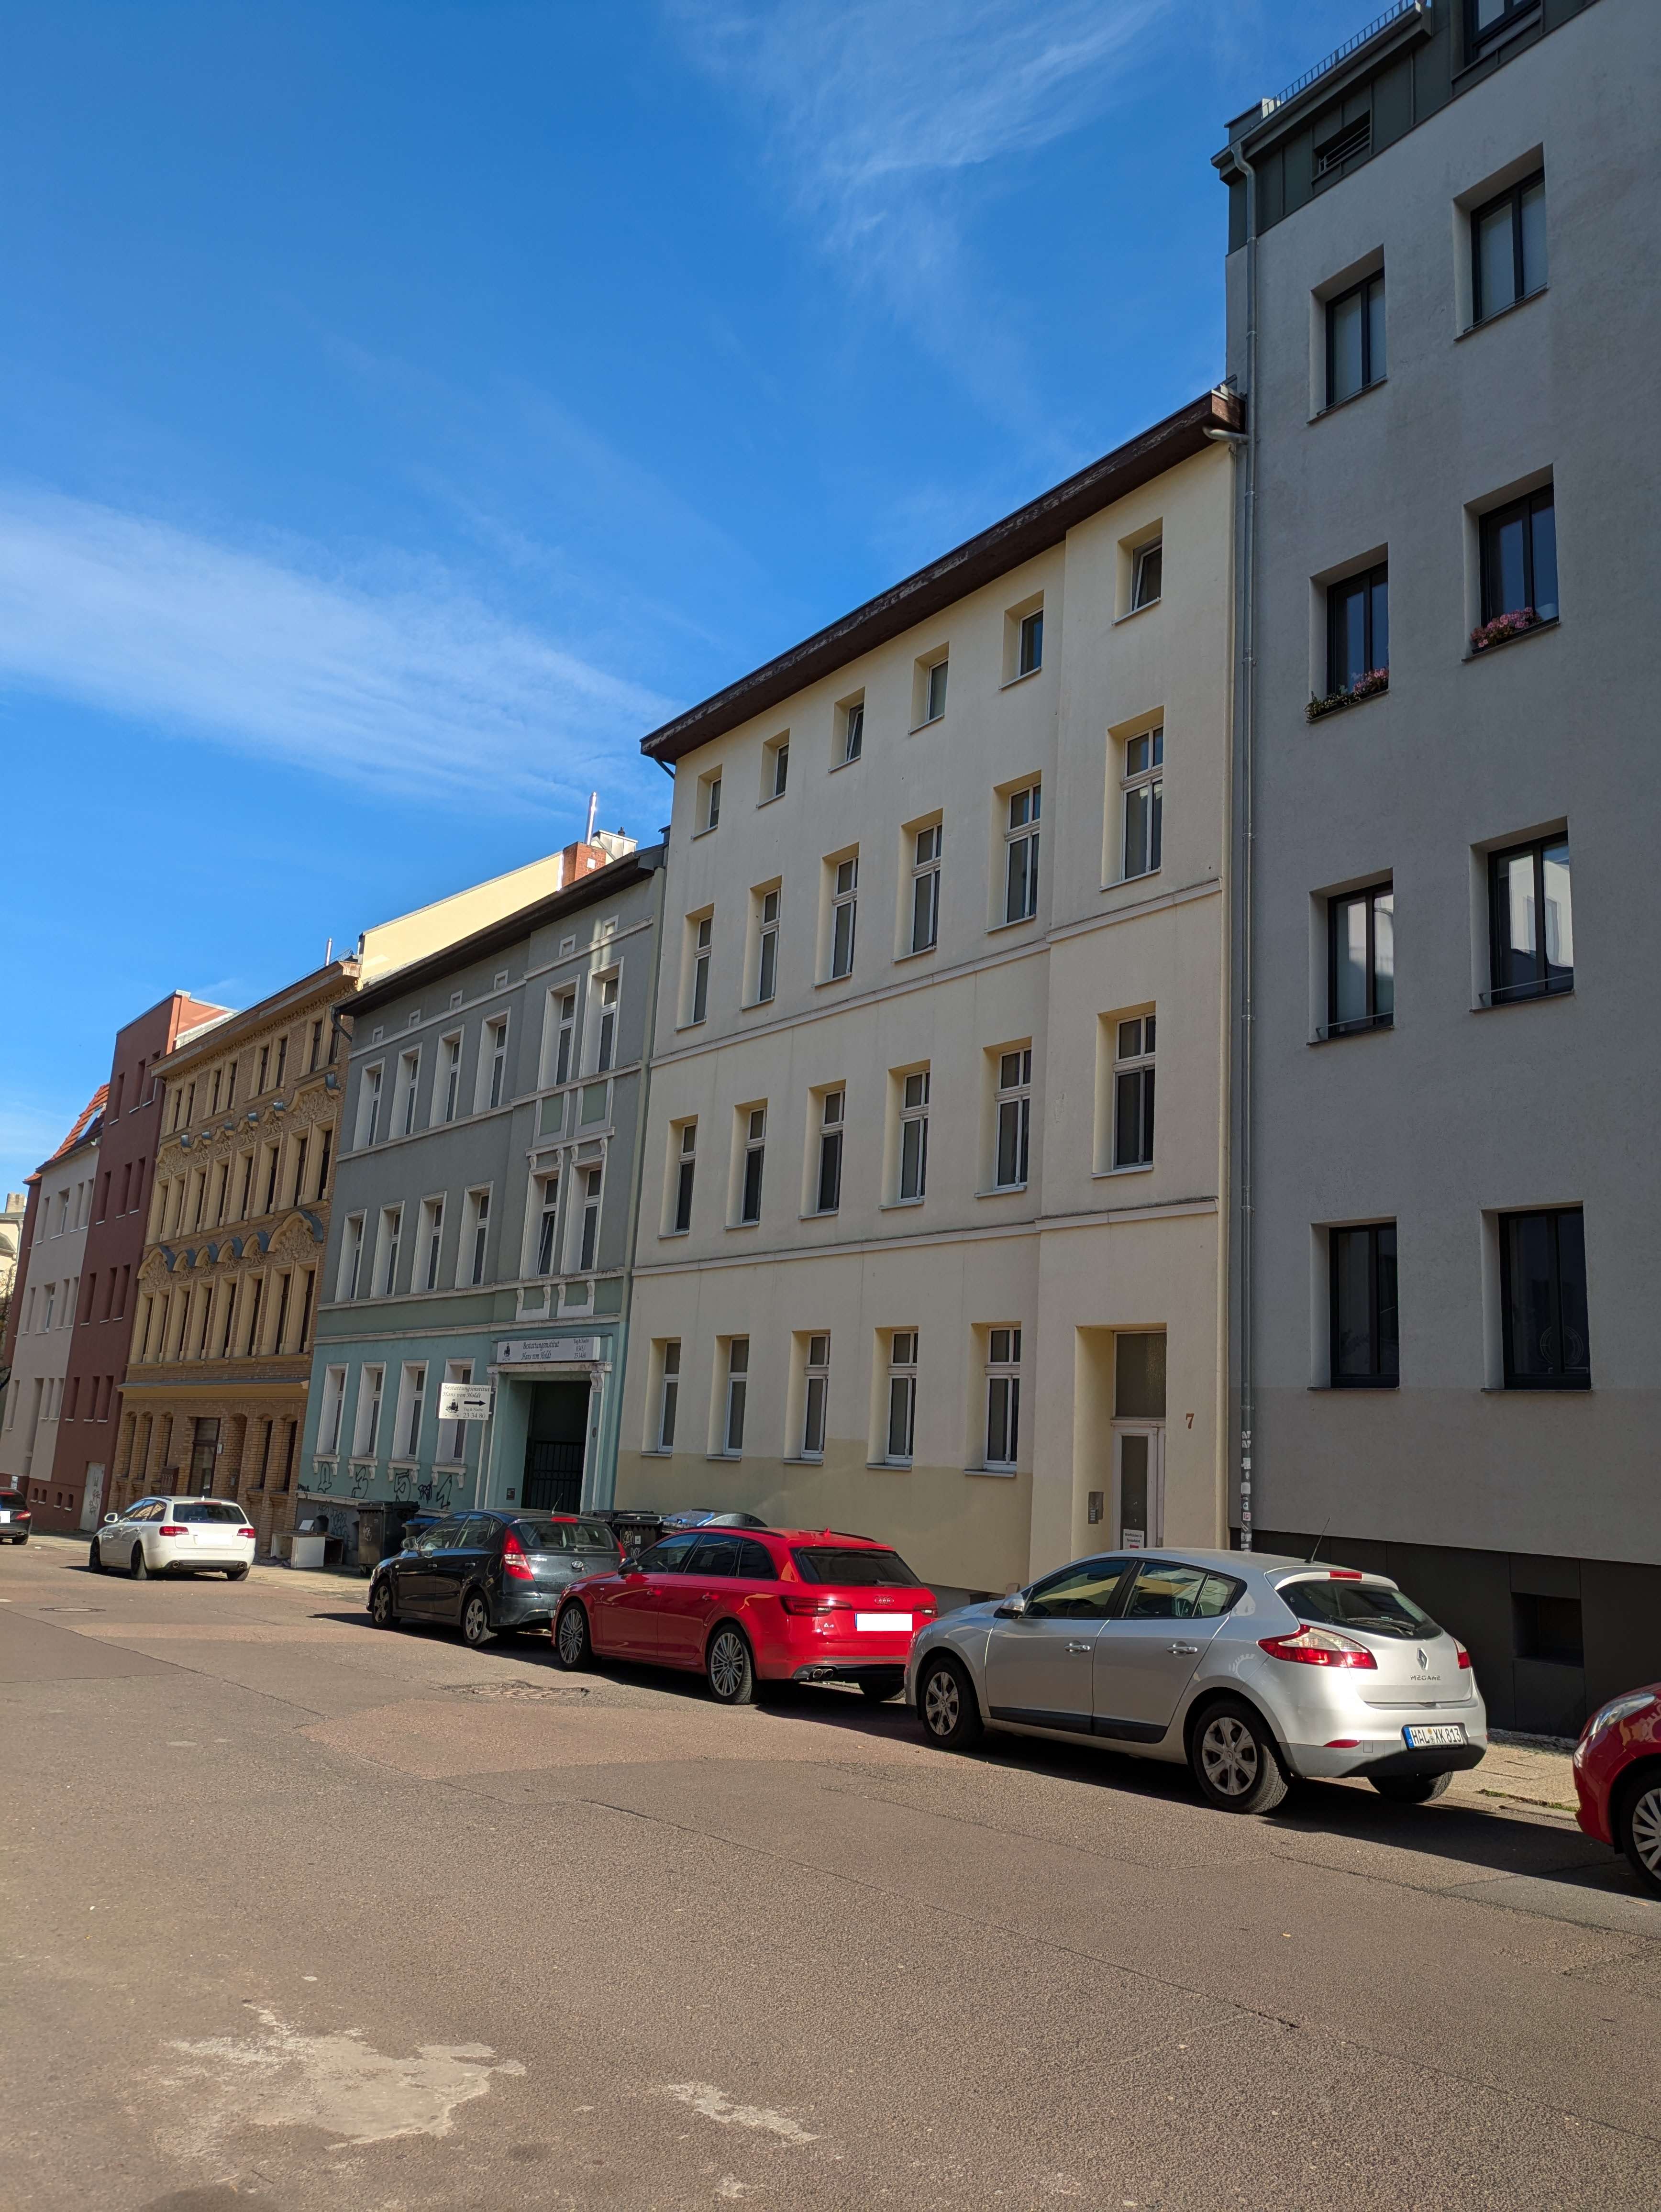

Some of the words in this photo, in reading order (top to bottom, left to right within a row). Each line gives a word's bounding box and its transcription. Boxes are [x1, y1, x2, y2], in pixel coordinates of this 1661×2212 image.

[522, 1340, 559, 1351] Bestattungsinstitut
[521, 1352, 532, 1360] Hans
[540, 1350, 552, 1360] Holdt
[1186, 1413, 1195, 1429] 7
[1411, 1729, 1430, 1744] HAL
[1433, 1728, 1446, 1743] XK
[1445, 1728, 1462, 1743] 813
